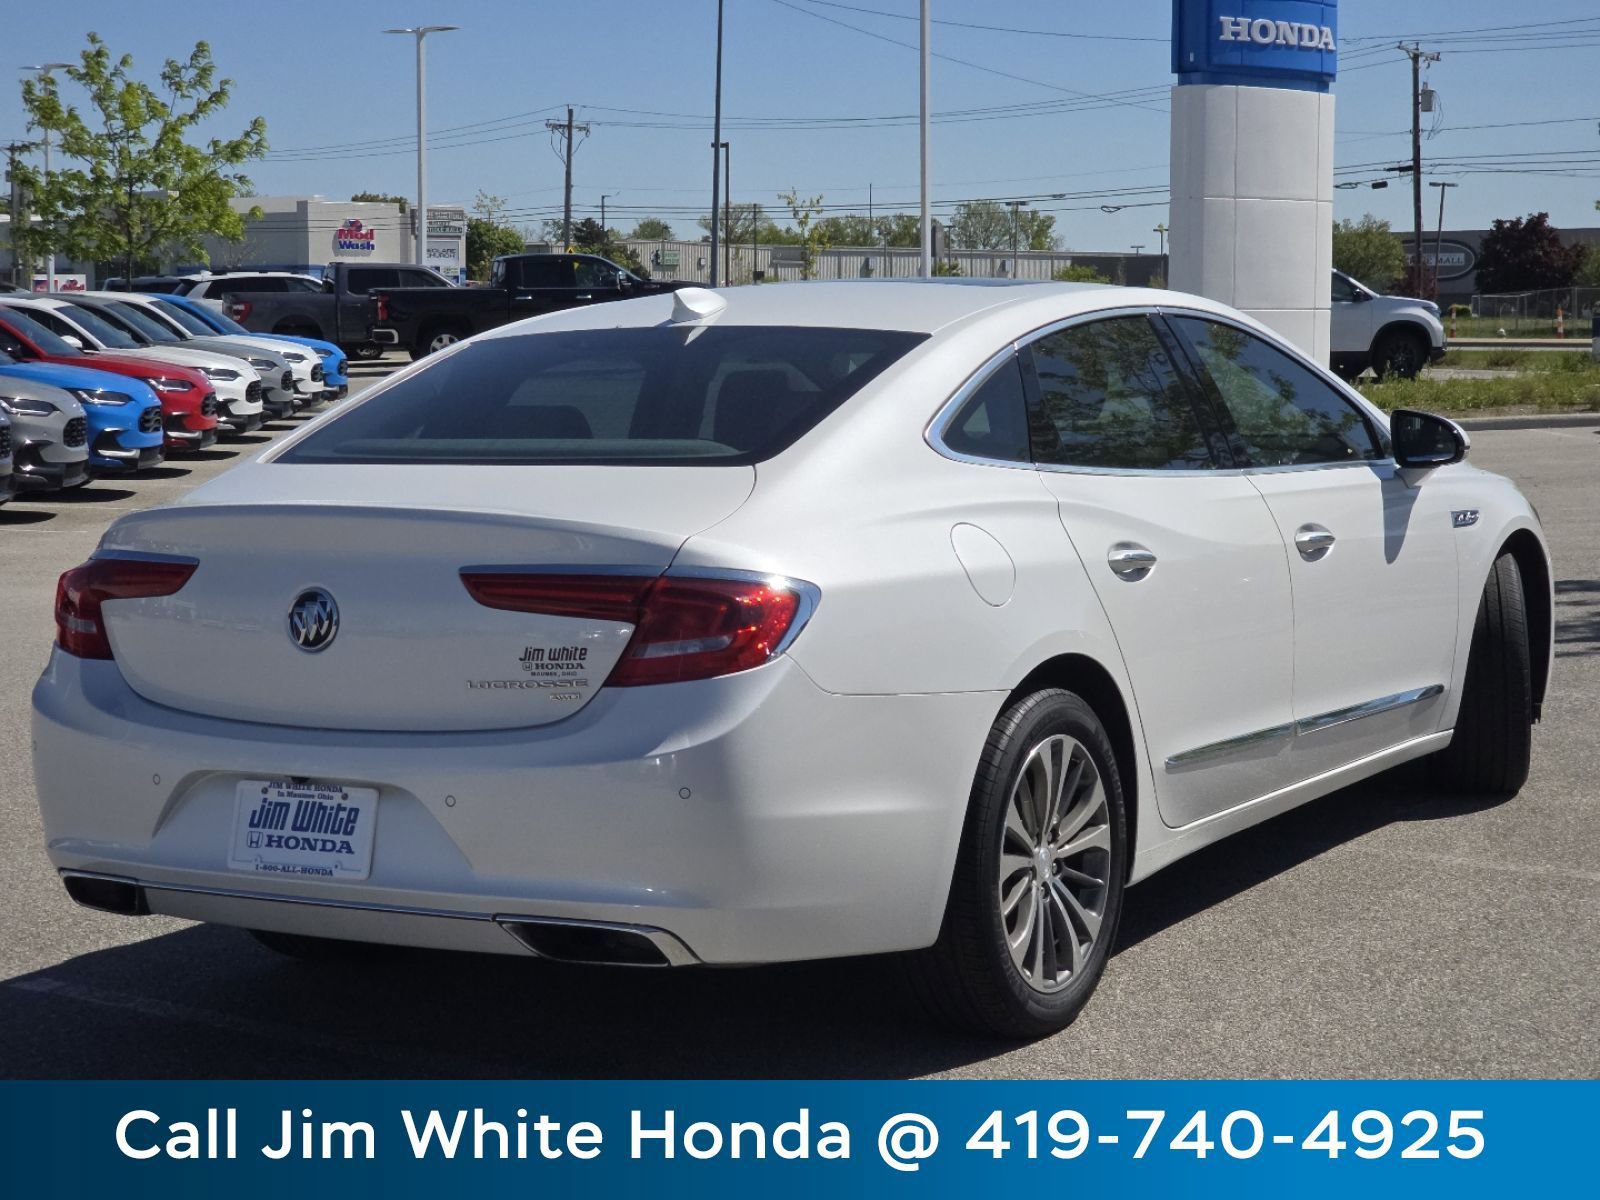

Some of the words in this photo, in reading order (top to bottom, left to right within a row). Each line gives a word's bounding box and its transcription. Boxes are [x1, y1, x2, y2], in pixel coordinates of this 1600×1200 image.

[1219, 16, 1337, 51] HONDA
[337, 228, 375, 241] Mod
[338, 240, 375, 251] Wash
[518, 646, 545, 662] Jim
[535, 662, 585, 670] HONDA
[550, 692, 581, 701] AWD
[268, 781, 283, 790] JIM
[285, 783, 313, 791] WHITE
[314, 784, 343, 793] HONDA
[249, 798, 290, 830] Jim
[291, 800, 360, 836] White
[265, 834, 355, 855] HONDA
[255, 863, 334, 877] 1-800-ALL-HONDA
